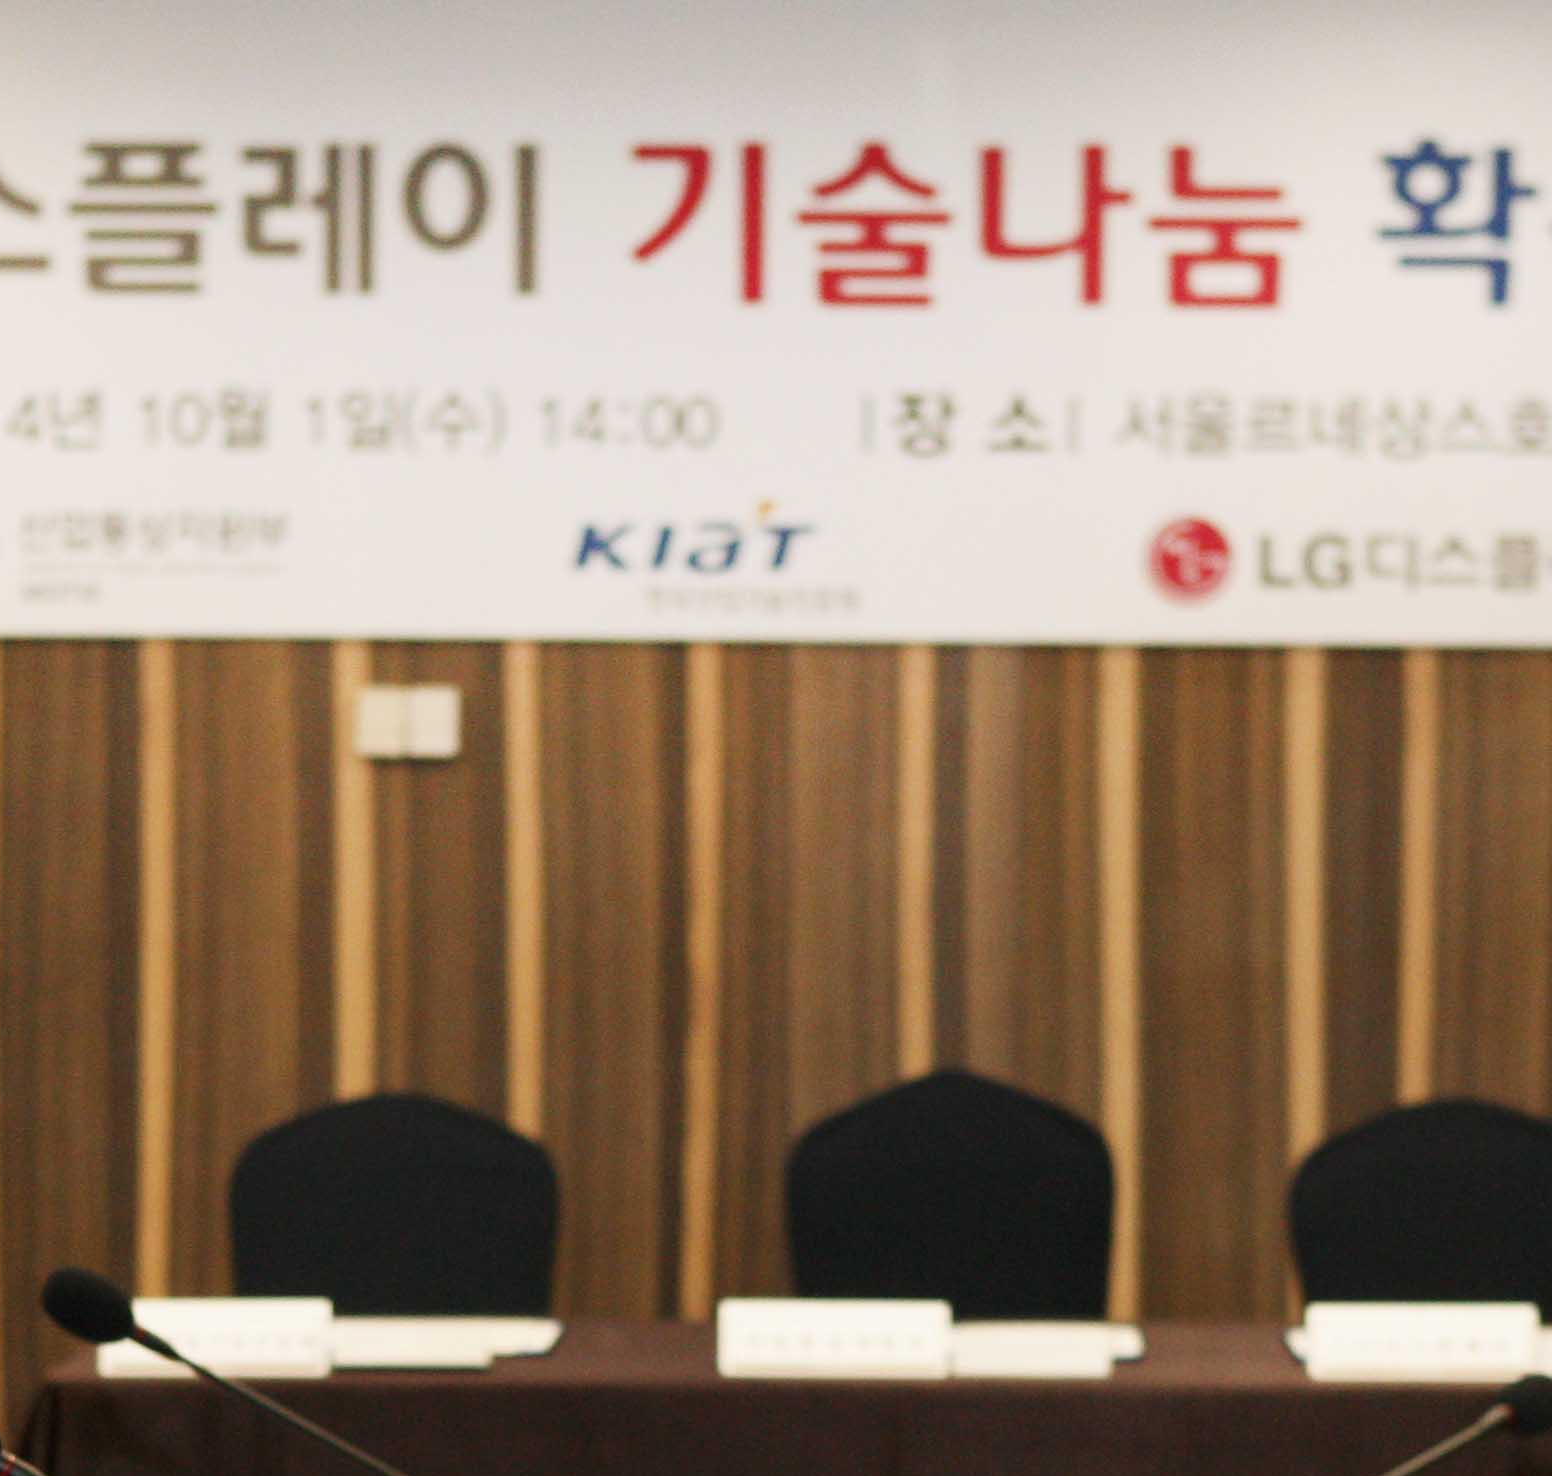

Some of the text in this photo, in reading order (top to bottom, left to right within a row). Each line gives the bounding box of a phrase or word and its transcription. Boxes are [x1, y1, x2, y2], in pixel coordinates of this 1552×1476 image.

[629, 141, 1304, 310] 기술나눔
[140, 390, 269, 453] 10월
[306, 390, 508, 455] 1일(수)
[539, 395, 722, 450] 14:00
